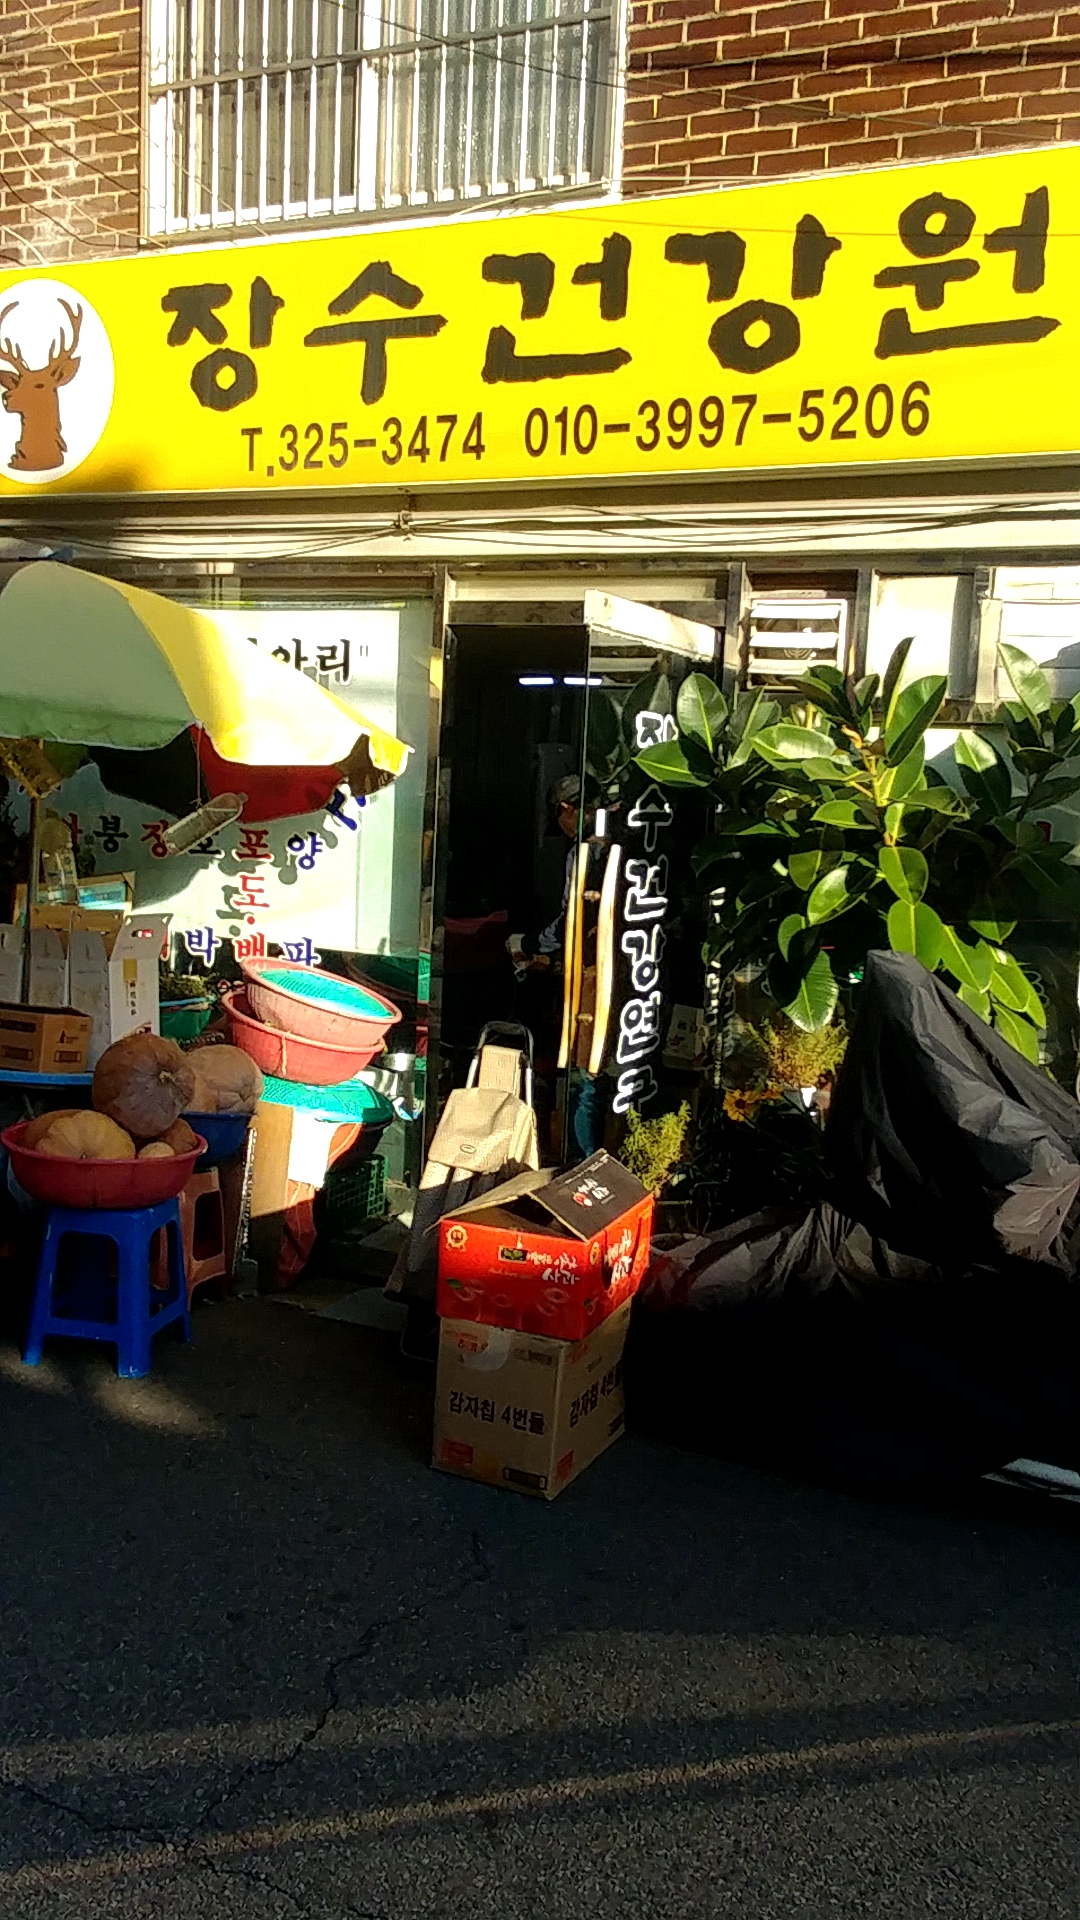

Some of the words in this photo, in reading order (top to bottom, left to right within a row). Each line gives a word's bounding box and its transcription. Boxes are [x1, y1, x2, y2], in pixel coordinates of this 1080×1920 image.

[161, 185, 1062, 411] 장수건강원
[241, 412, 485, 477] T.325-3474
[524, 380, 931, 458] 010-3997-5206
